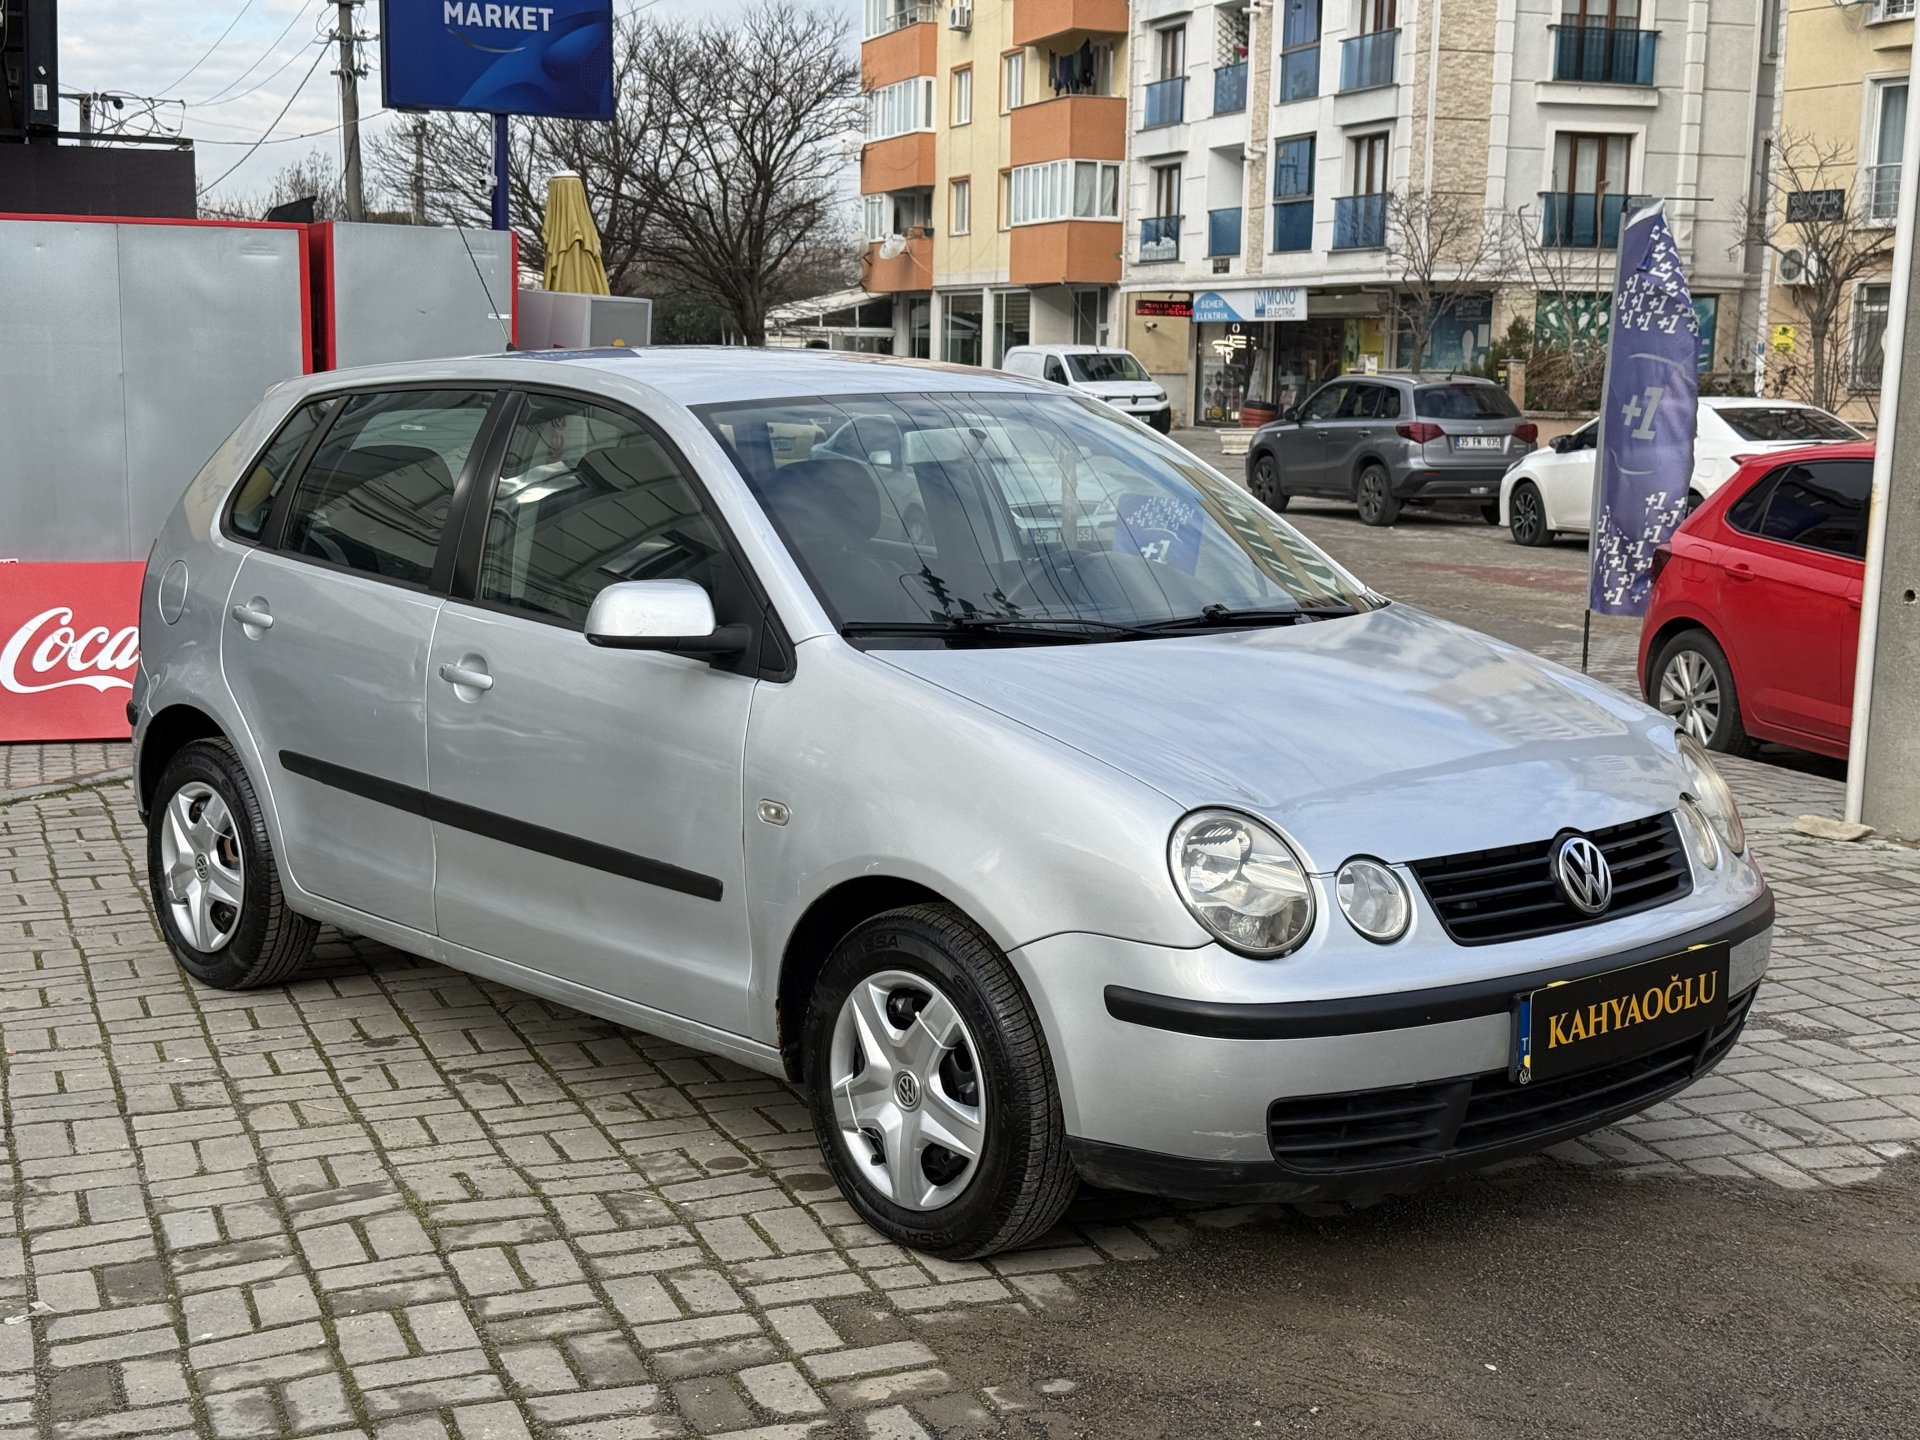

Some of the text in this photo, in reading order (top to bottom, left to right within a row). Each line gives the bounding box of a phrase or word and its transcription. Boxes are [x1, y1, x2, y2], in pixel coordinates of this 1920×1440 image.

[443, 1, 554, 32] MARKET
[1267, 288, 1296, 305] MONO
[1631, 293, 1645, 312] +1
[1648, 295, 1669, 315] +1
[1267, 307, 1296, 318] ELECTRIC
[1636, 312, 1652, 331] +1
[1657, 315, 1679, 334] +1
[1622, 386, 1664, 440] +1
[1645, 492, 1667, 510] +1
[1140, 539, 1170, 565] +1
[1626, 541, 1645, 558] +1
[1603, 587, 1624, 605] +1
[0, 607, 139, 693] Coca
[1548, 970, 1718, 1049] KAHYAOĞLU
